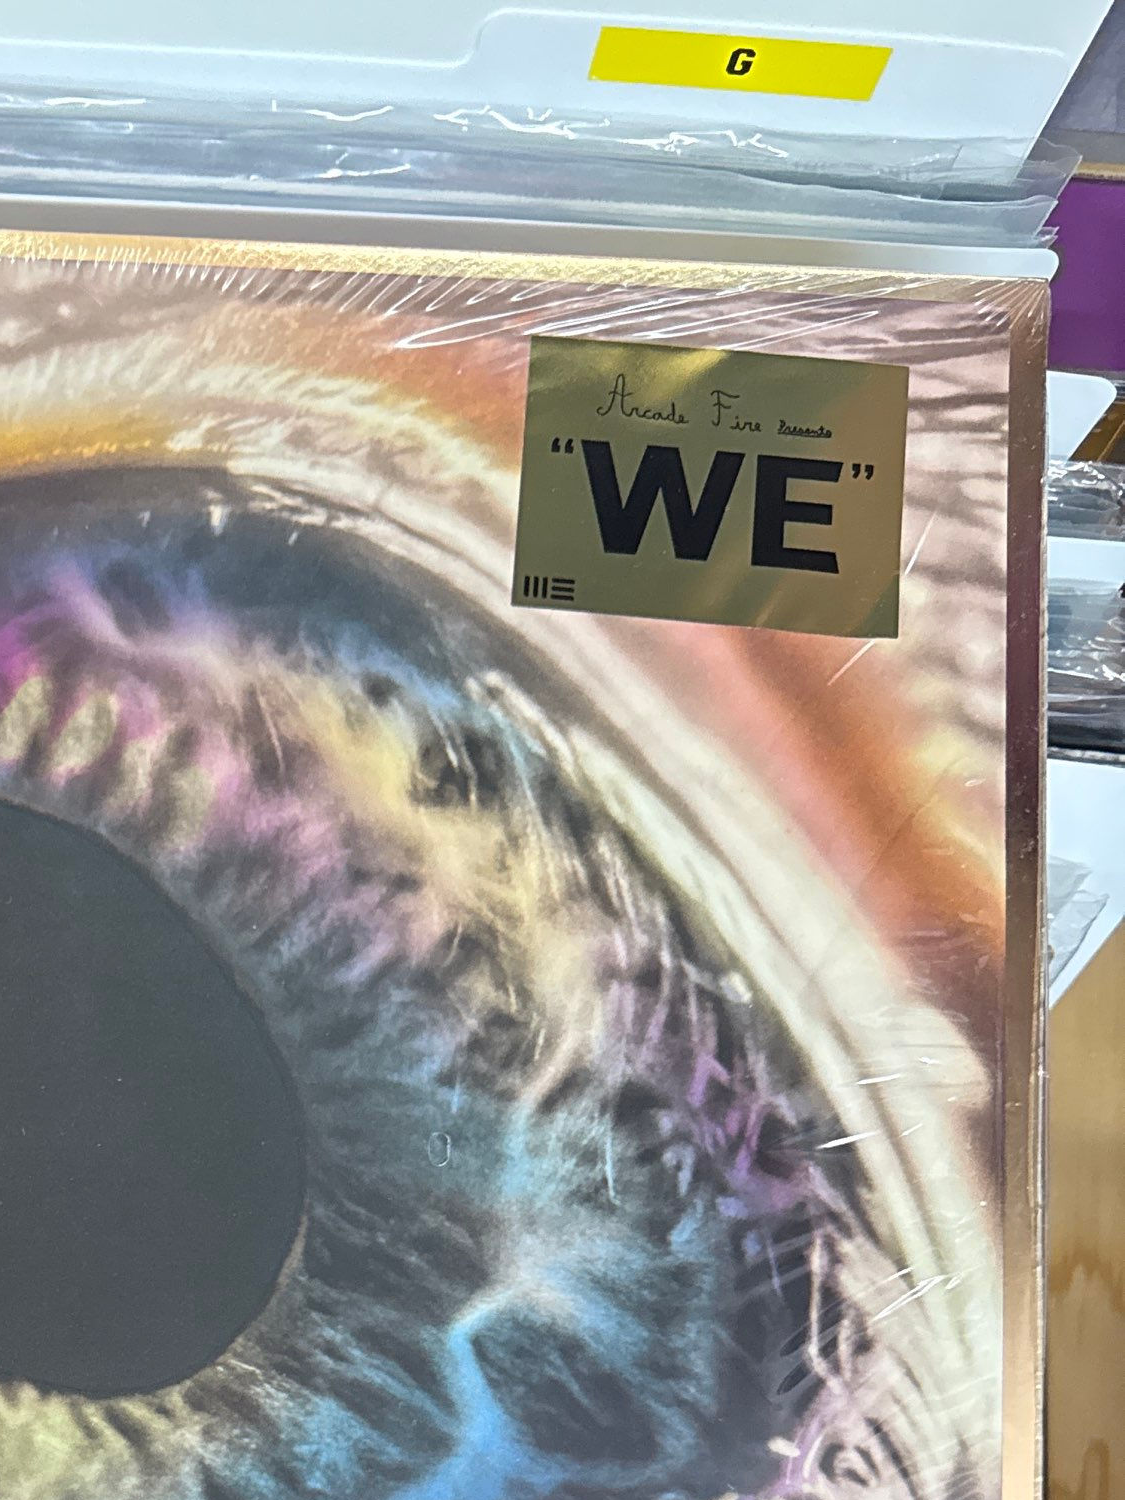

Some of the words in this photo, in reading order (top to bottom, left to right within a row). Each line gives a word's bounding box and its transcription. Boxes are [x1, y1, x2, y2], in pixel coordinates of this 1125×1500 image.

[726, 47, 756, 76] G
[596, 373, 689, 425] Arcade
[710, 390, 762, 432] Fire
